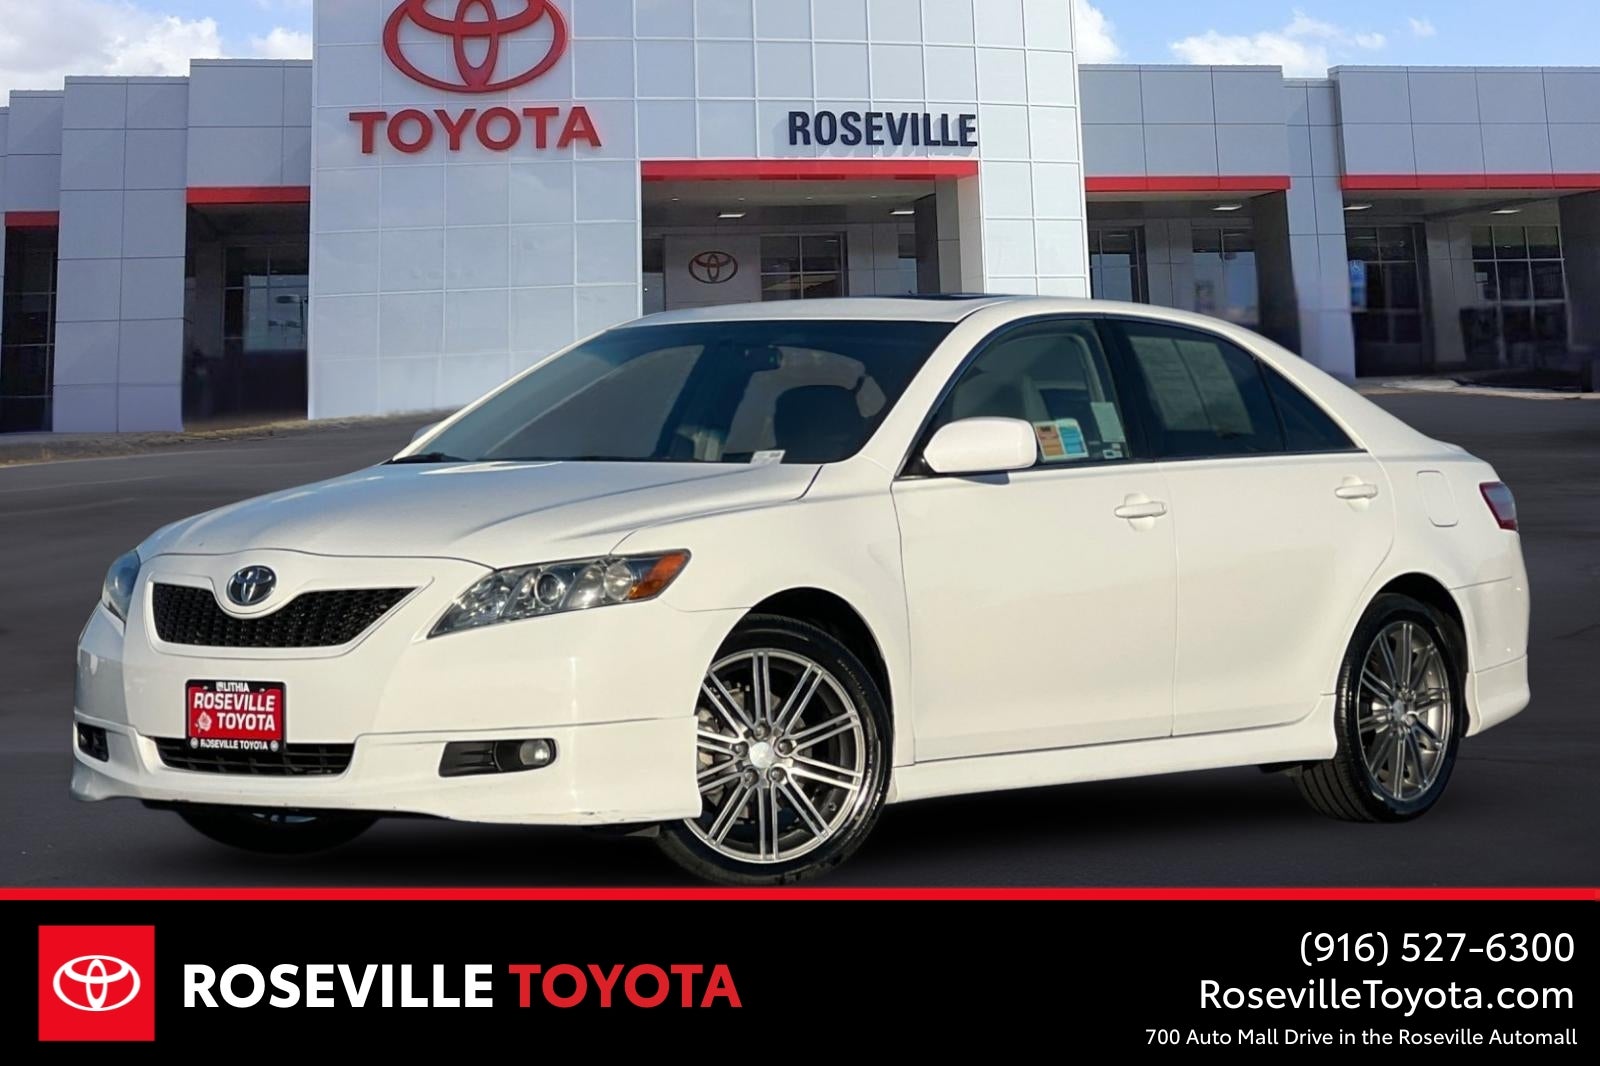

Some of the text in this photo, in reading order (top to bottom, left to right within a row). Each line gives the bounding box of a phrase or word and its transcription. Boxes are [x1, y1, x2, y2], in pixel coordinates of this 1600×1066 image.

[349, 106, 602, 154] TOYOTA
[788, 110, 978, 147] ROSEVILLE
[223, 682, 250, 692] LITHIA
[194, 692, 275, 712] ROSEVILLE
[217, 713, 275, 731] TOYOTA
[200, 739, 269, 750] ROSEVILLE TOYOTA
